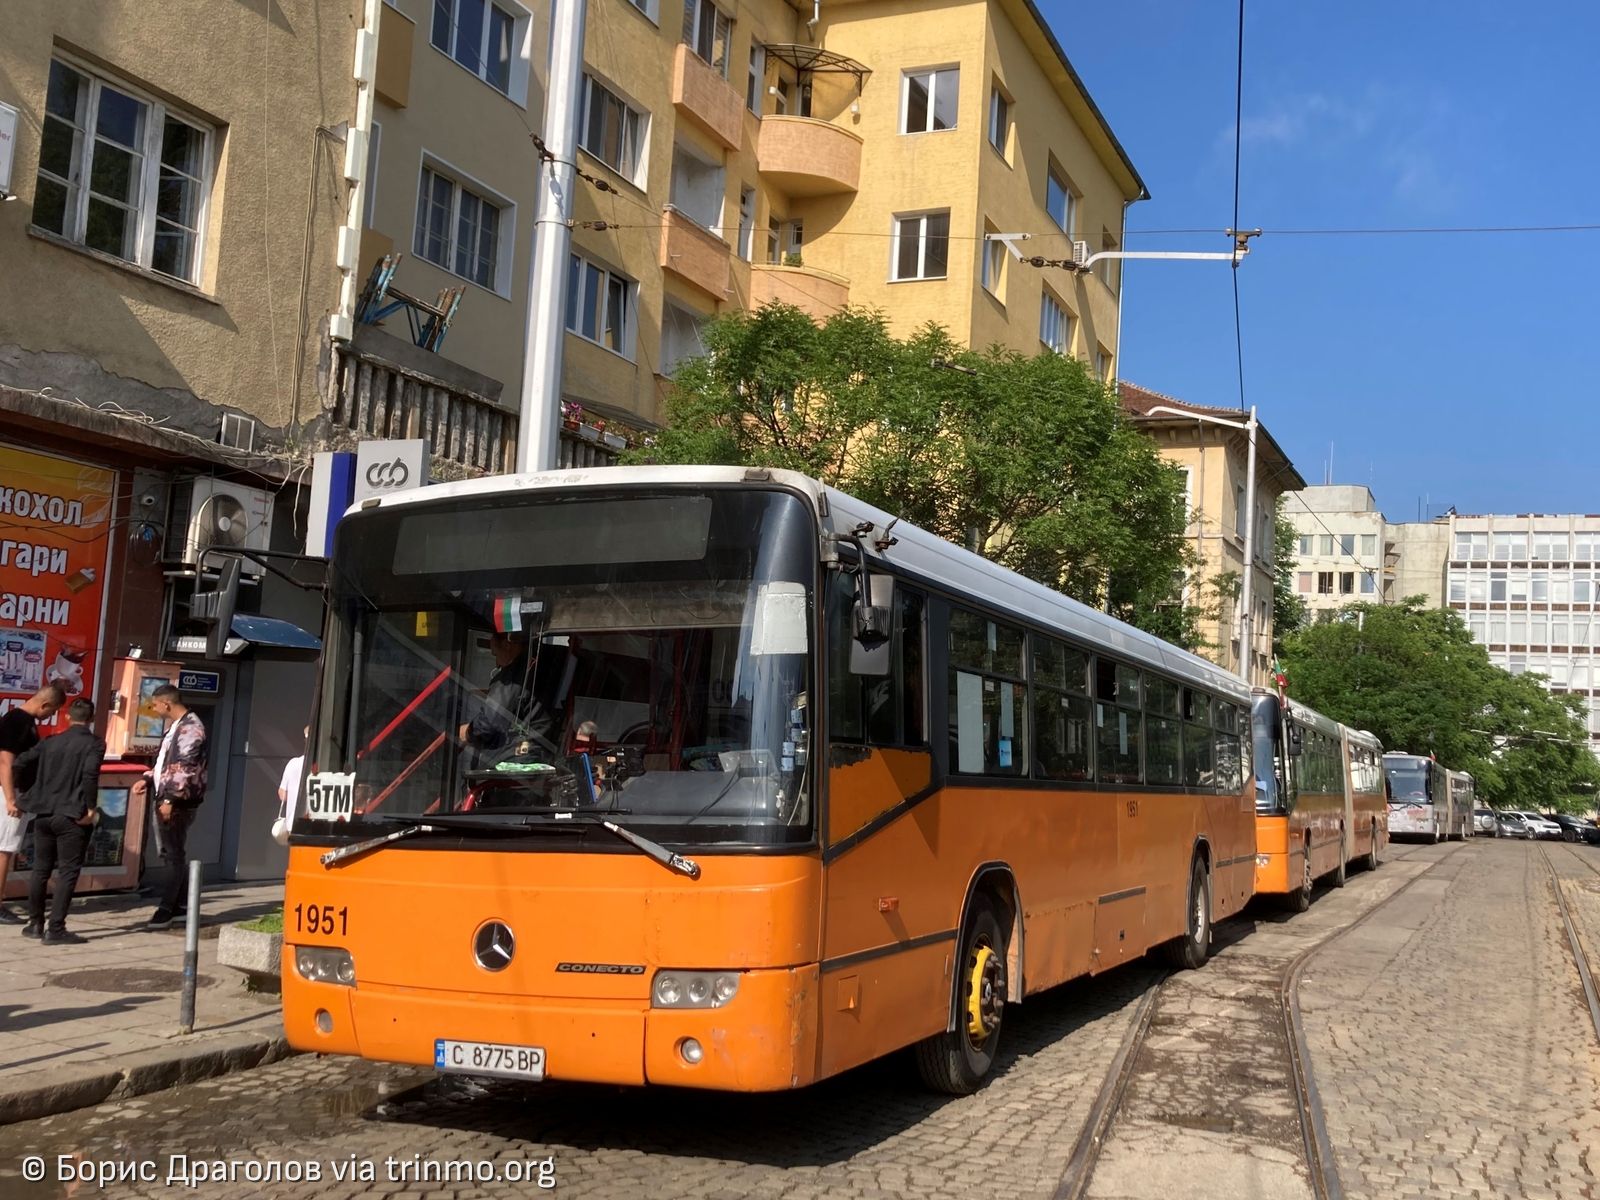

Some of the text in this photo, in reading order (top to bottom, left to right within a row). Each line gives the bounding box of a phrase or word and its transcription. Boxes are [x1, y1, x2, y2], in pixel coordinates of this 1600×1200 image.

[171, 640, 206, 649] БАНКОМ
[295, 903, 348, 936] 1951
[558, 963, 644, 974] CONECTO
[453, 1045, 463, 1065] C
